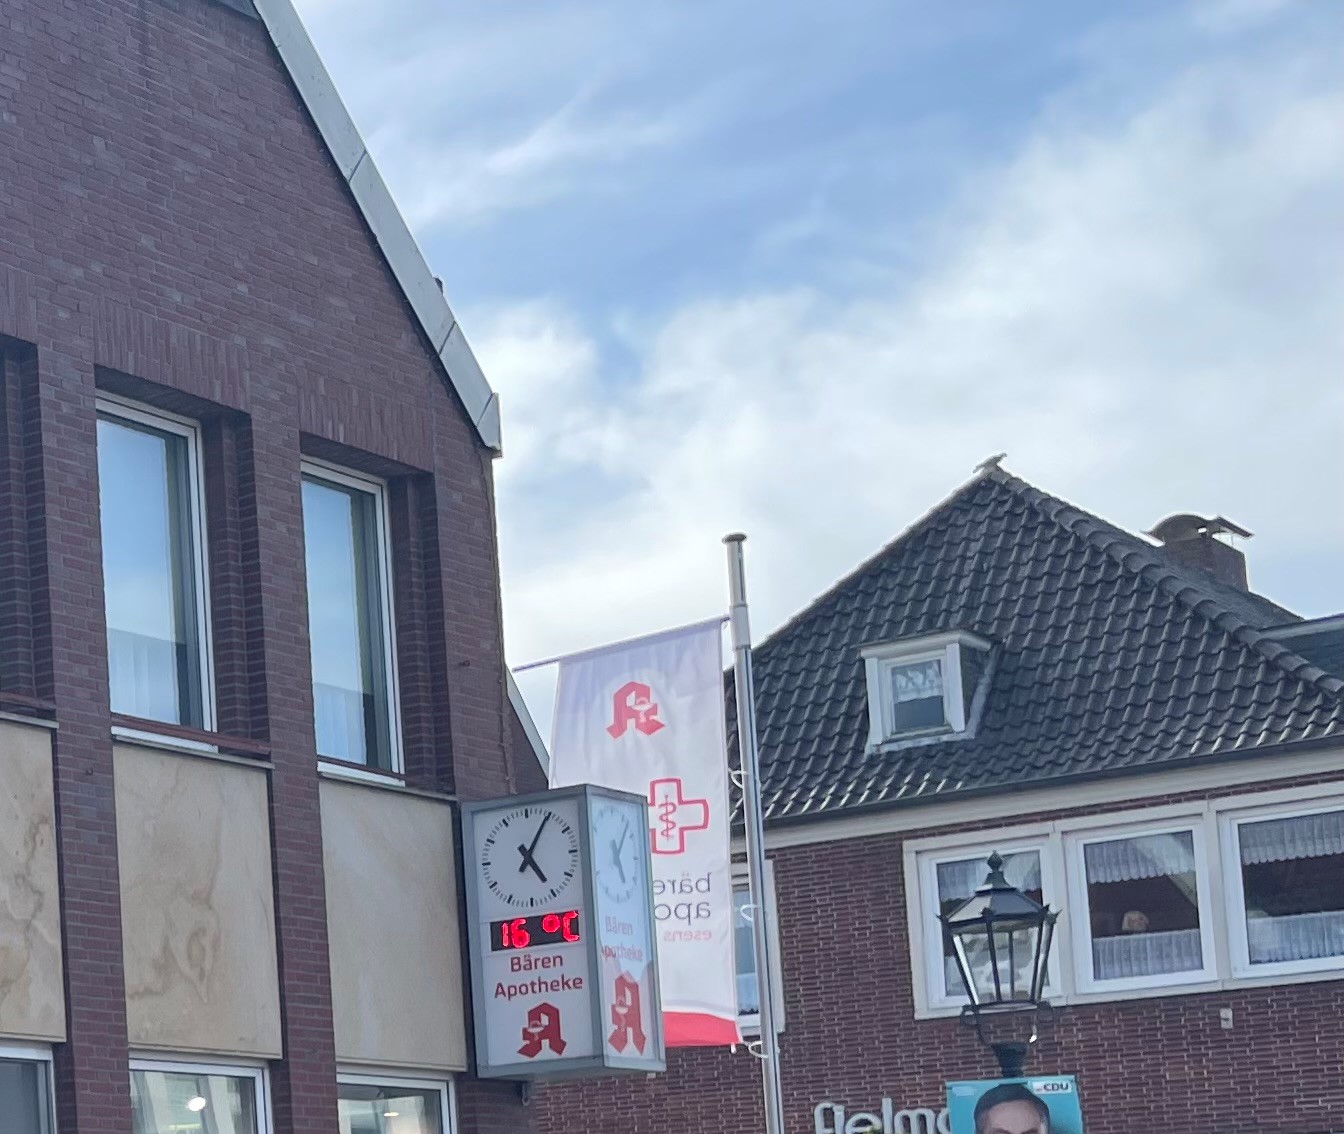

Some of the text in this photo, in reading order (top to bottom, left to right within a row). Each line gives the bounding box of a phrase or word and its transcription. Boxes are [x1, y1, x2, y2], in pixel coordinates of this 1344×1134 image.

[510, 954, 563, 973] Bären
[494, 974, 583, 1000] Apotheke
[1043, 1082, 1069, 1091] CDU
